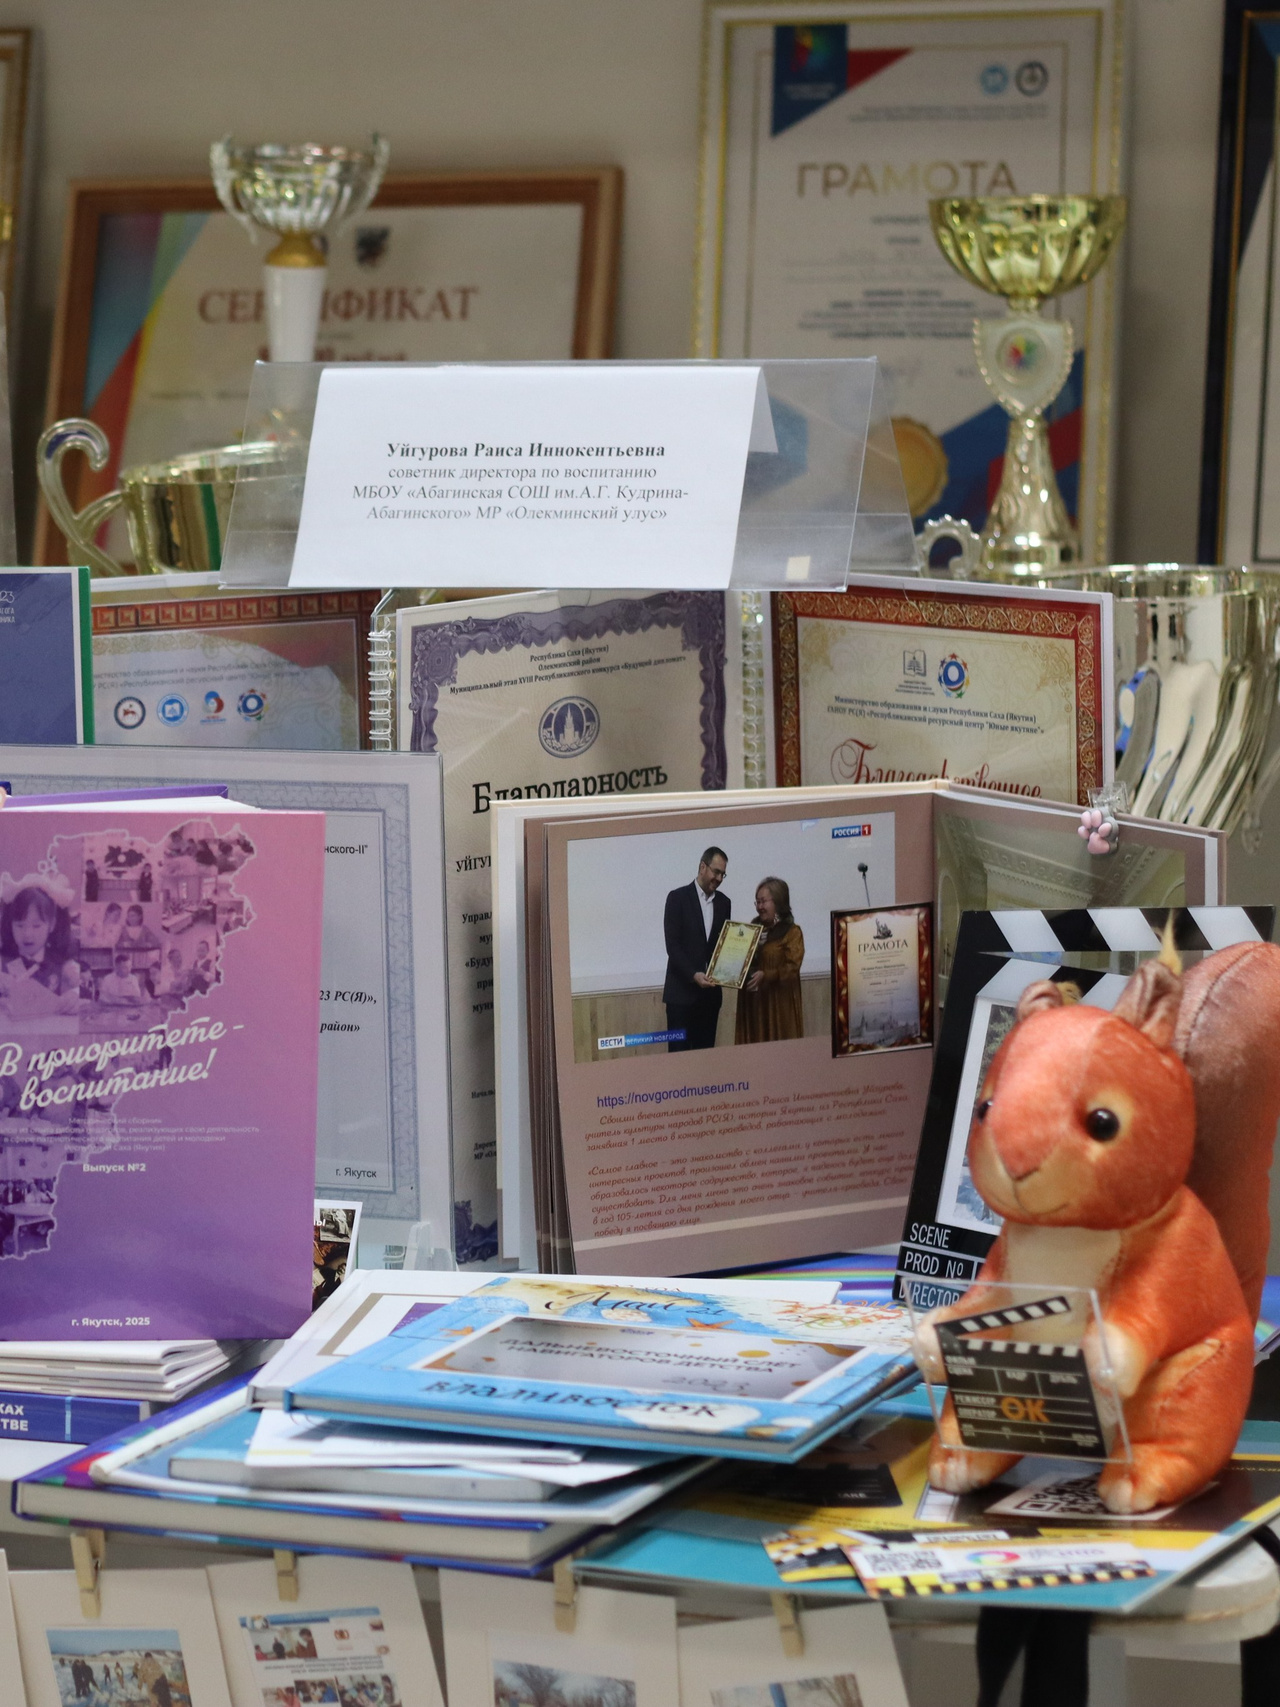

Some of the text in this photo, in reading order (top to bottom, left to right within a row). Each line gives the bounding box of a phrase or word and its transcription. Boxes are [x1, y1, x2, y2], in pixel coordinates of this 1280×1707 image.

[797, 160, 1016, 198] ГРАМОТА
[387, 441, 666, 460] Уйгурова Раиса Иннокентьевна
[388, 466, 657, 481] советник директора по воспитанию
[353, 485, 403, 500] МБОУ
[407, 485, 504, 501] «Абагинская
[507, 485, 550, 500] СОШ
[616, 485, 690, 502] Кудрина-
[366, 505, 668, 523] Абагинского» МР «Олекминский улус»
[581, 656, 601, 667] район
[450, 680, 503, 695] Муниципальный
[503, 678, 518, 687] этап
[833, 826, 869, 837] РОССИЯ 1
[857, 938, 909, 953] ГРАМОТА
[334, 990, 377, 1005] РС(Я)»,
[320, 1020, 360, 1034] район»
[27, 1016, 227, 1081] приоритете
[600, 1038, 623, 1048] ВЕСТИ
[654, 1032, 685, 1042] НОВГОРОД
[19, 1048, 217, 1111] воспитание!
[596, 1081, 750, 1109] https://novgorodmuseum.ru
[82, 1162, 125, 1174] Выпуск
[335, 1167, 377, 1179] г. Якутск
[909, 1222, 952, 1249] SCENE
[903, 1250, 940, 1275] PROD
[81, 1316, 123, 1329] Якутск,
[124, 1316, 150, 1326] 2025
[499, 1338, 741, 1365] ДАЛЬНЕВОСТОЧНЫЙ
[506, 1345, 775, 1374] НАВИГАТОРОВ ДЕТСТВА
[1001, 1396, 1051, 1424] OK
